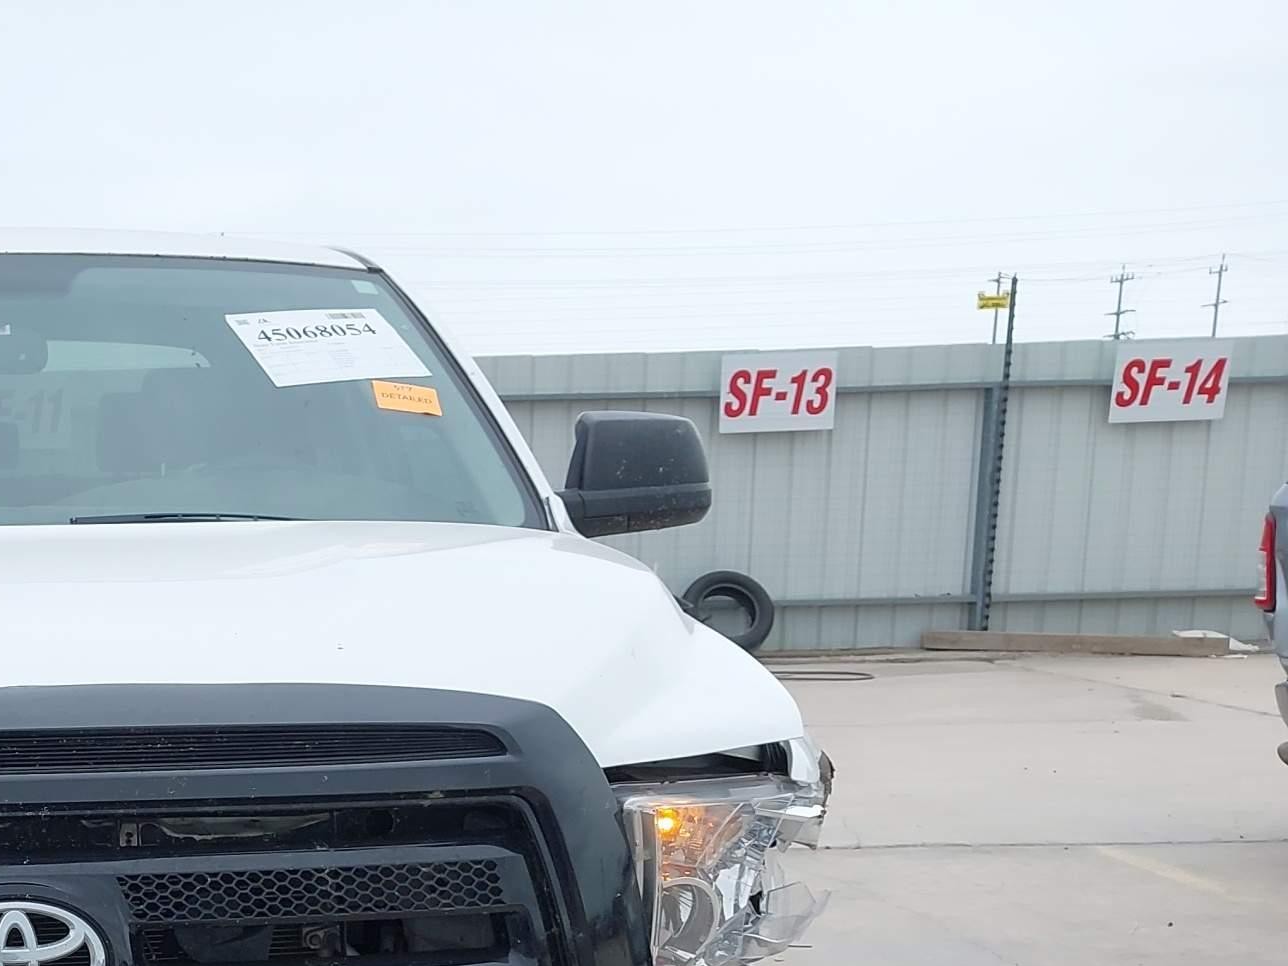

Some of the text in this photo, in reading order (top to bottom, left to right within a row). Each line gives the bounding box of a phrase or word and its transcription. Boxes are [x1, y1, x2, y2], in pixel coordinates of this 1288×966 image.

[257, 322, 377, 342] 45068054
[724, 367, 833, 418] SF-13
[1115, 357, 1228, 408] SF-14
